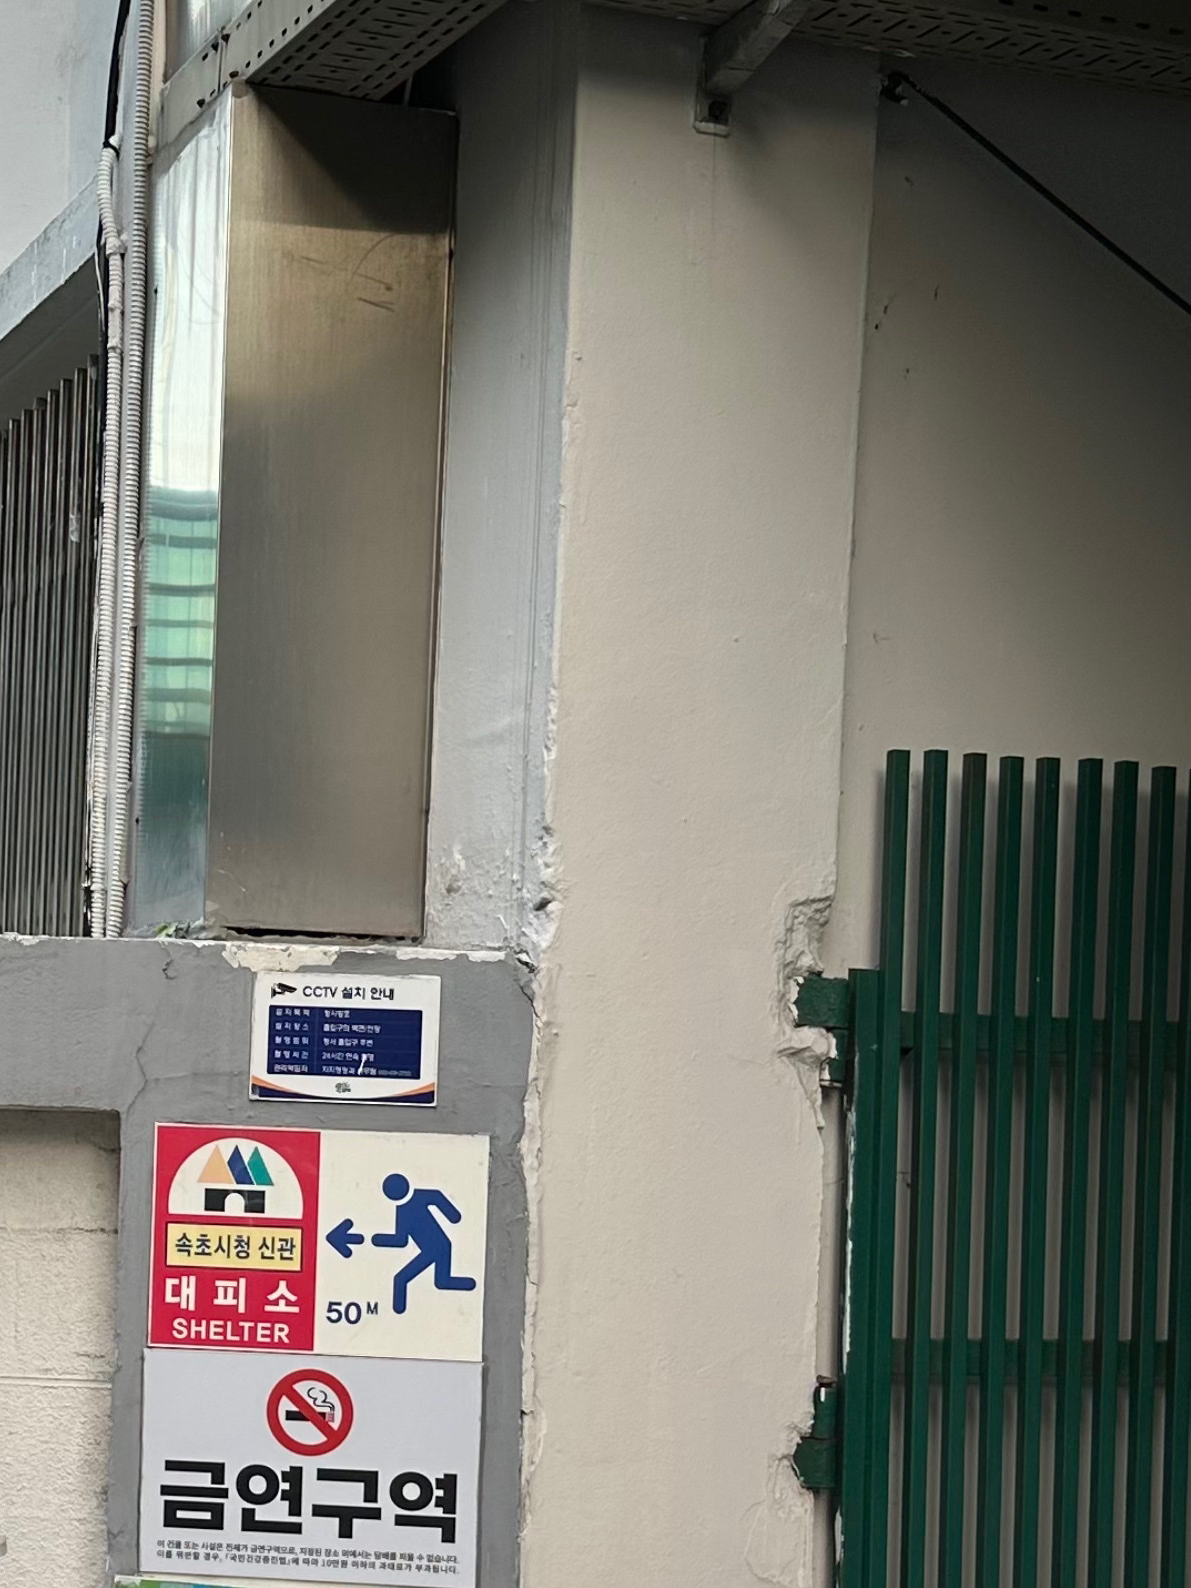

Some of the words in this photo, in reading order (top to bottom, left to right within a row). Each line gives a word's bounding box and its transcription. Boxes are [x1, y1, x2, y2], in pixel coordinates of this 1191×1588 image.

[303, 986, 338, 998] CCTV
[342, 987, 366, 1000] 설치
[370, 987, 395, 1001] 안내
[175, 1232, 251, 1259] 속초시청
[258, 1236, 296, 1262] 신관
[171, 1317, 290, 1344] SHELTER
[160, 1459, 458, 1544] 금연구역
